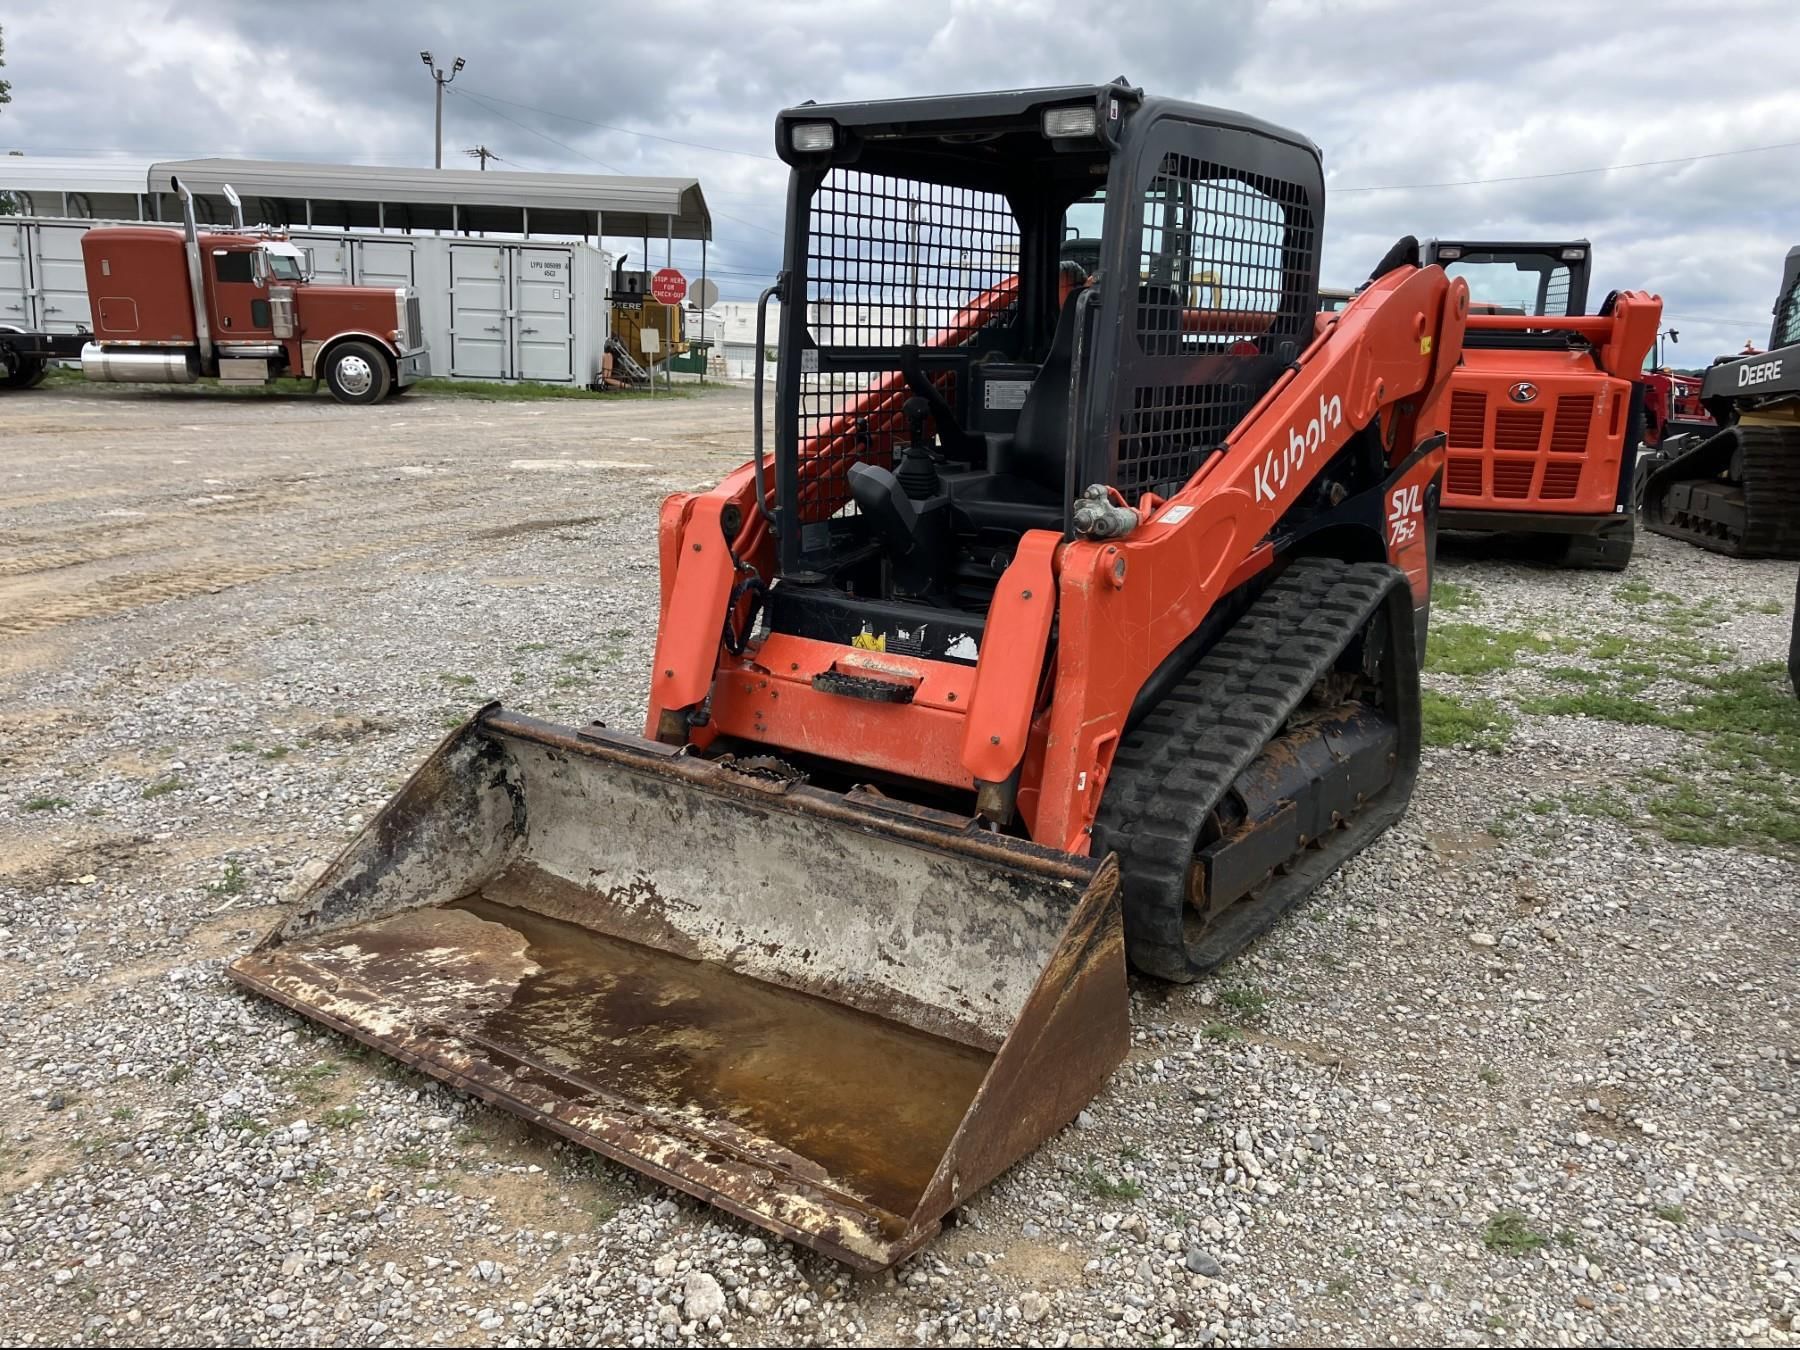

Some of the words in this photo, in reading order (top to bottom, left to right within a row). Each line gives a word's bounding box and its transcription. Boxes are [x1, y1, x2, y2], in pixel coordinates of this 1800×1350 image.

[653, 275, 668, 283] STOP
[663, 283, 675, 291] FOR
[1738, 360, 1783, 387] DEERE
[1254, 394, 1342, 503] Kubota
[1389, 485, 1423, 521] SVL
[1389, 518, 1417, 547] 75-2
